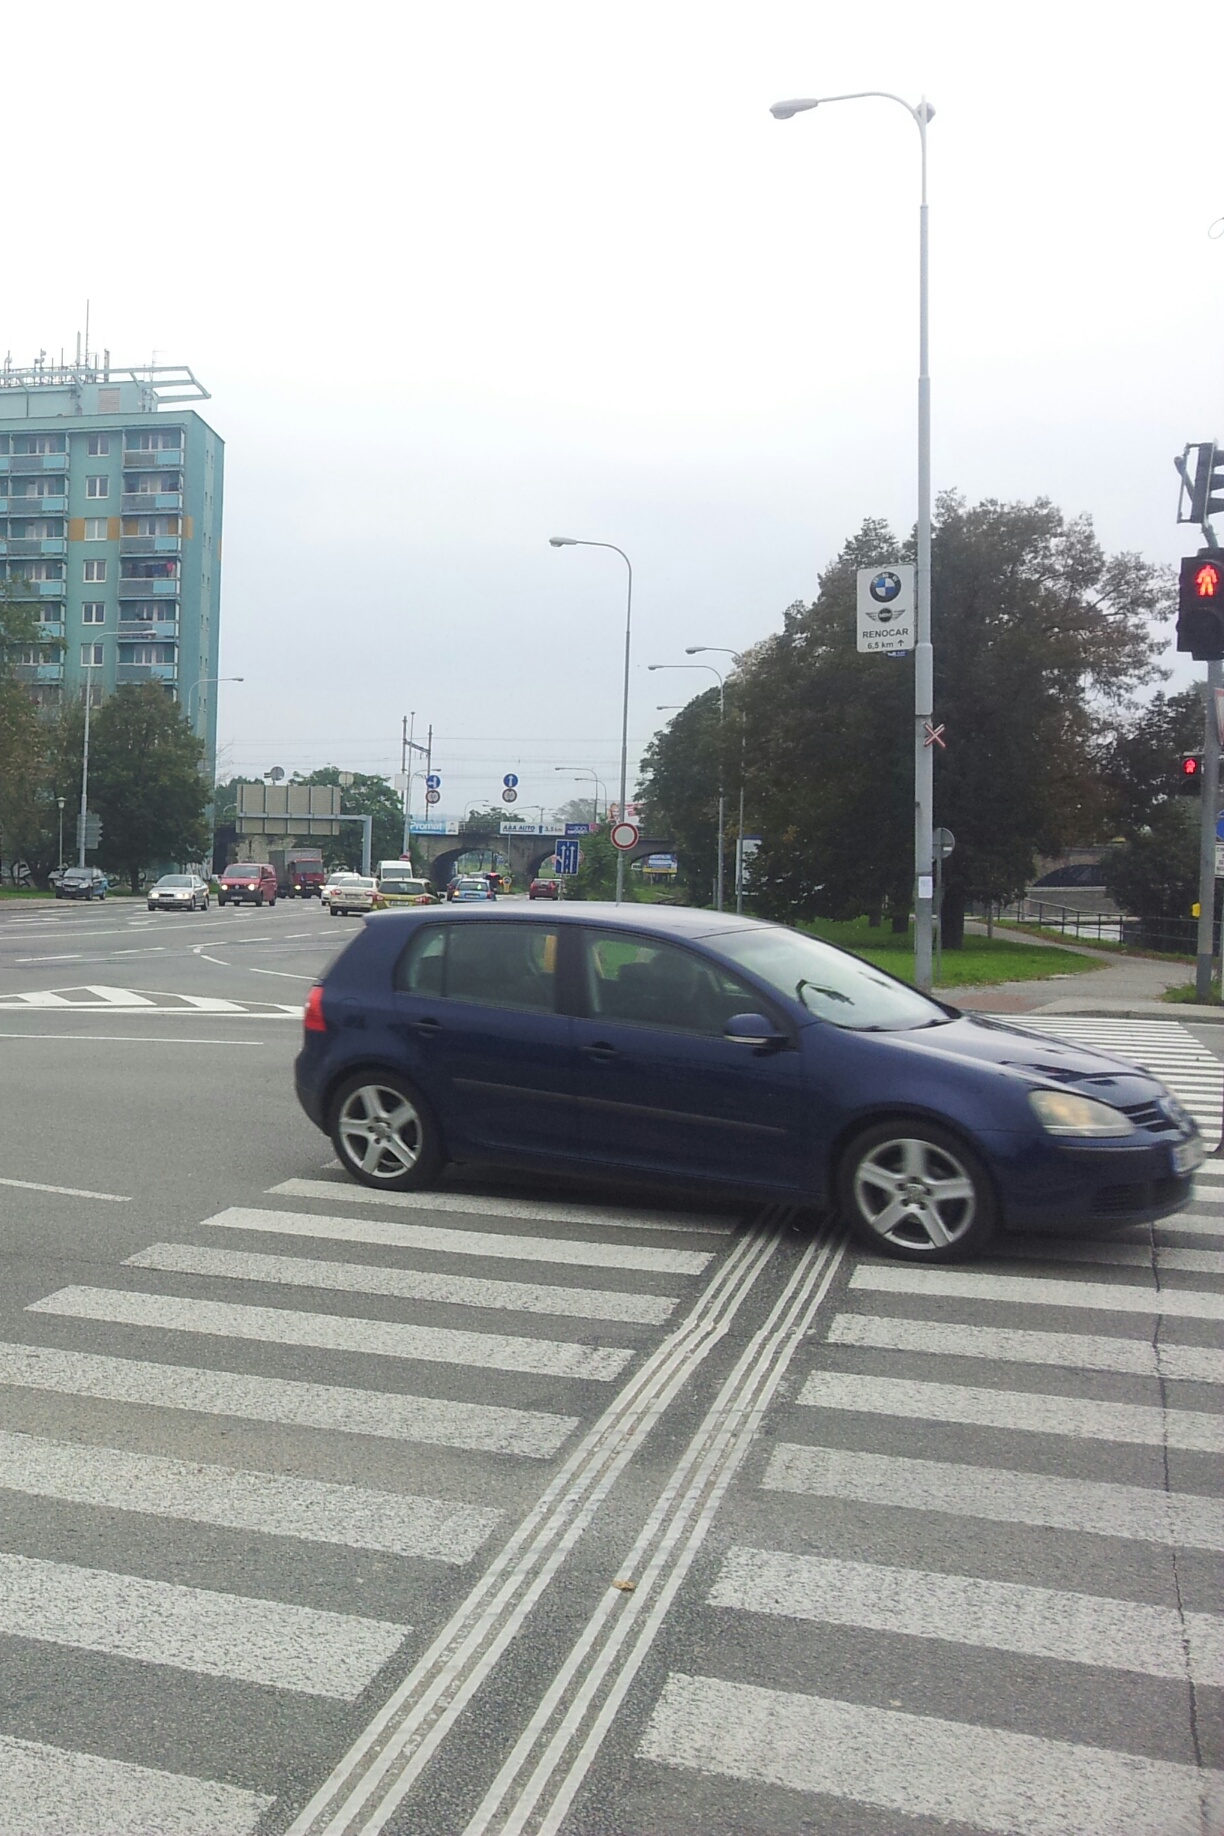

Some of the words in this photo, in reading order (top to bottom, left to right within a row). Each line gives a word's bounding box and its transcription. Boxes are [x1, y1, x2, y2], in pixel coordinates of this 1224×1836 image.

[862, 628, 909, 638] RENOCAR
[867, 642, 879, 650] 6,5
[409, 821, 442, 830] Promat
